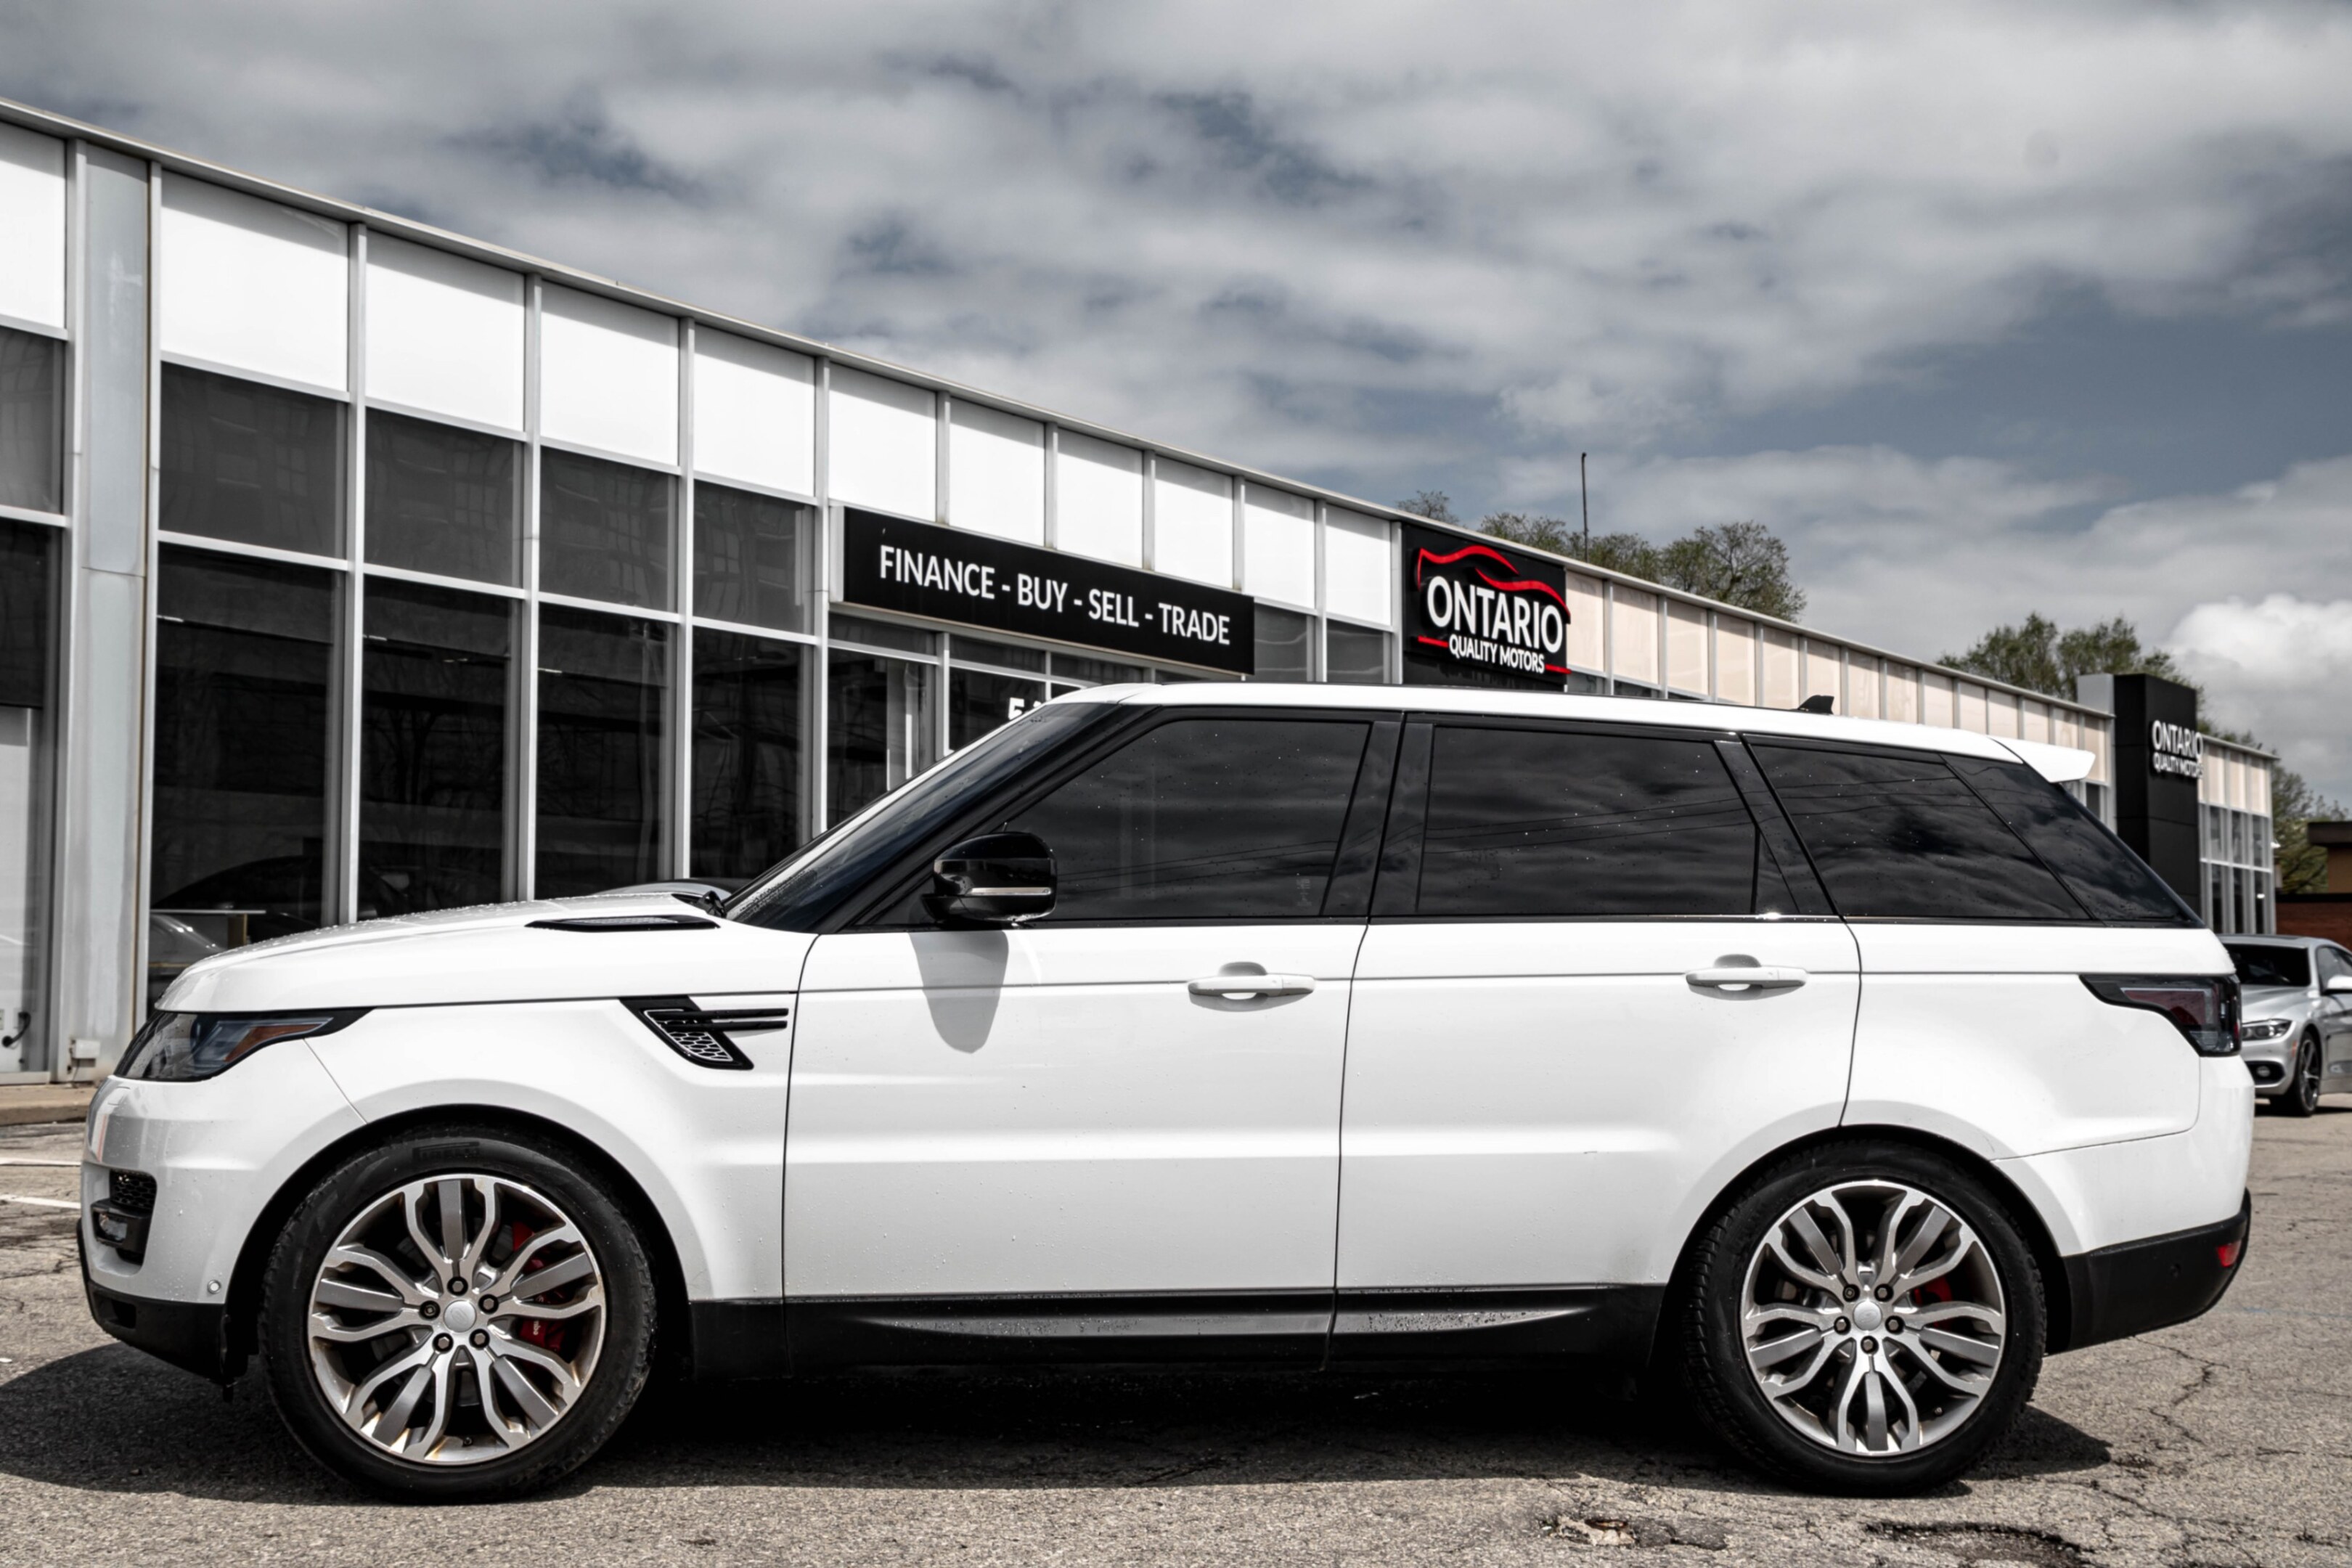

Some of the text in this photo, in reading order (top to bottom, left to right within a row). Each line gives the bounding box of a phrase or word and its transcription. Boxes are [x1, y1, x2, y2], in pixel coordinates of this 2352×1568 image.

[880, 544, 995, 600] FINANCE
[1017, 573, 1068, 613] BUY
[1088, 588, 1140, 628] SELL
[1158, 602, 1230, 645] TRADE
[1427, 576, 1563, 653] ONTARIO
[1449, 634, 1545, 674] QUALITY MOTORS
[2152, 719, 2204, 759] ONTARIO
[2153, 752, 2179, 773] QUALITY
